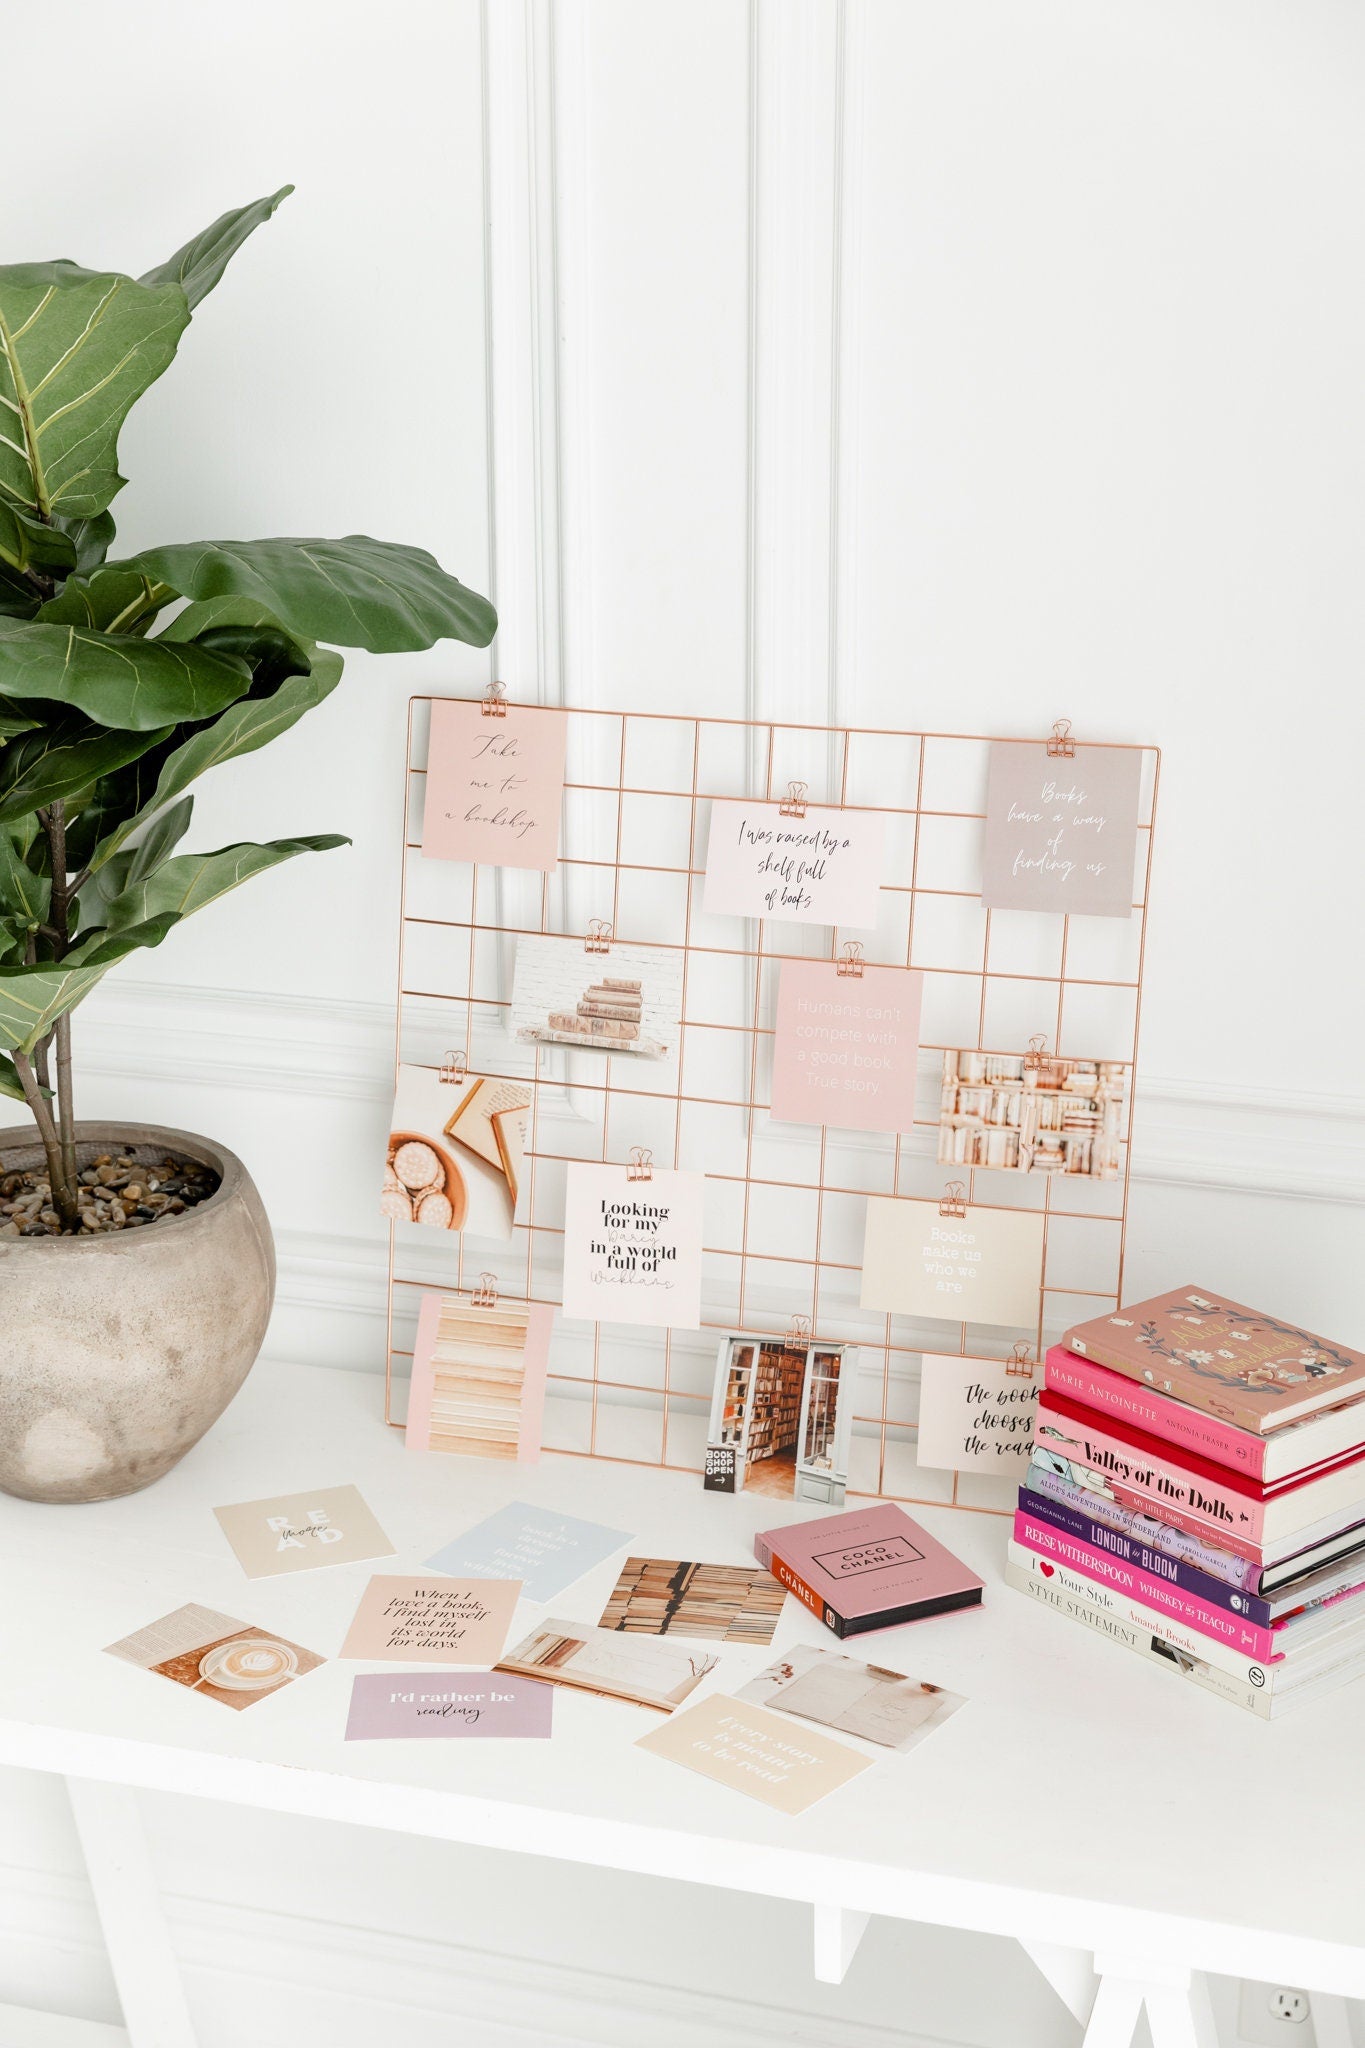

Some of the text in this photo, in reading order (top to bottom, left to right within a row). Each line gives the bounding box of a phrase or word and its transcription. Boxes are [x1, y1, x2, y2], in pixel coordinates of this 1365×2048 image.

[472, 734, 522, 759] Take
[470, 774, 528, 793] me to
[1040, 781, 1088, 805] Books
[445, 804, 538, 838] a bookshop
[1007, 802, 1106, 833] have a way
[738, 820, 851, 856] I was raised by a
[1047, 829, 1063, 855] of
[758, 851, 827, 883] shelf full
[1012, 849, 1107, 882] finding us
[764, 886, 812, 911] of books
[797, 998, 901, 1021] Humans can't
[796, 1025, 897, 1045] compete with
[798, 1050, 891, 1069] a good book
[806, 1072, 881, 1096] True story
[601, 1199, 670, 1222] Looking
[604, 1214, 661, 1234] for my
[608, 1229, 660, 1249] Darcy
[930, 1227, 976, 1244] Books
[590, 1240, 677, 1260] in a world
[922, 1245, 982, 1262] make us
[607, 1255, 661, 1272] full of
[924, 1262, 977, 1278] who we
[935, 1280, 963, 1294] are
[996, 1385, 1040, 1406] book
[1050, 1366, 1084, 1390] MARIE
[1088, 1384, 1158, 1421] ANTOINETTE
[1166, 1419, 1200, 1441] ANTONIA
[1201, 1433, 1230, 1451] FRASER
[973, 1409, 1036, 1433] chooses
[706, 1450, 734, 1459] BOOK
[963, 1435, 1034, 1456] the read
[705, 1458, 734, 1467] SHOP
[705, 1466, 734, 1476] OPEN
[1083, 1441, 1133, 1480] Valley
[1134, 1470, 1156, 1487] of
[1157, 1478, 1185, 1501] the
[1188, 1489, 1234, 1524] Dolls
[1039, 1479, 1066, 1496] ALICE'S
[1066, 1490, 1111, 1517] ADVENTURES
[1111, 1511, 1121, 1521] IN
[1121, 1518, 1172, 1546] WONDERLAND
[1133, 1497, 1184, 1526] MY LITTLE PARIS
[1027, 1500, 1178, 1582] GEORGIANNA LANE LONDON in BLOOM
[841, 1552, 904, 1570] CHANEL
[842, 1547, 886, 1561] COCO
[780, 1567, 814, 1608] CHANEL
[1025, 1525, 1056, 1551] REESE
[1057, 1540, 1134, 1588] WITHERSPOON
[1139, 1582, 1185, 1613] WHISKEY
[1196, 1609, 1236, 1636] TEACUP
[388, 1598, 424, 1607] love
[414, 1590, 473, 1600] When I
[1031, 1557, 1197, 1651] I Your Style Amanda Brooks
[381, 1607, 491, 1622] I find myself
[405, 1617, 457, 1628] lost in
[1027, 1581, 1138, 1645] STYLE STATEMENT
[386, 1637, 459, 1650] for days.
[390, 1627, 467, 1639] its world
[390, 1691, 516, 1703] I'd rather be
[416, 1703, 486, 1724] reading
[713, 1732, 796, 1770] is meant
[716, 1716, 824, 1766] Every story
[691, 1740, 790, 1783] to be read
